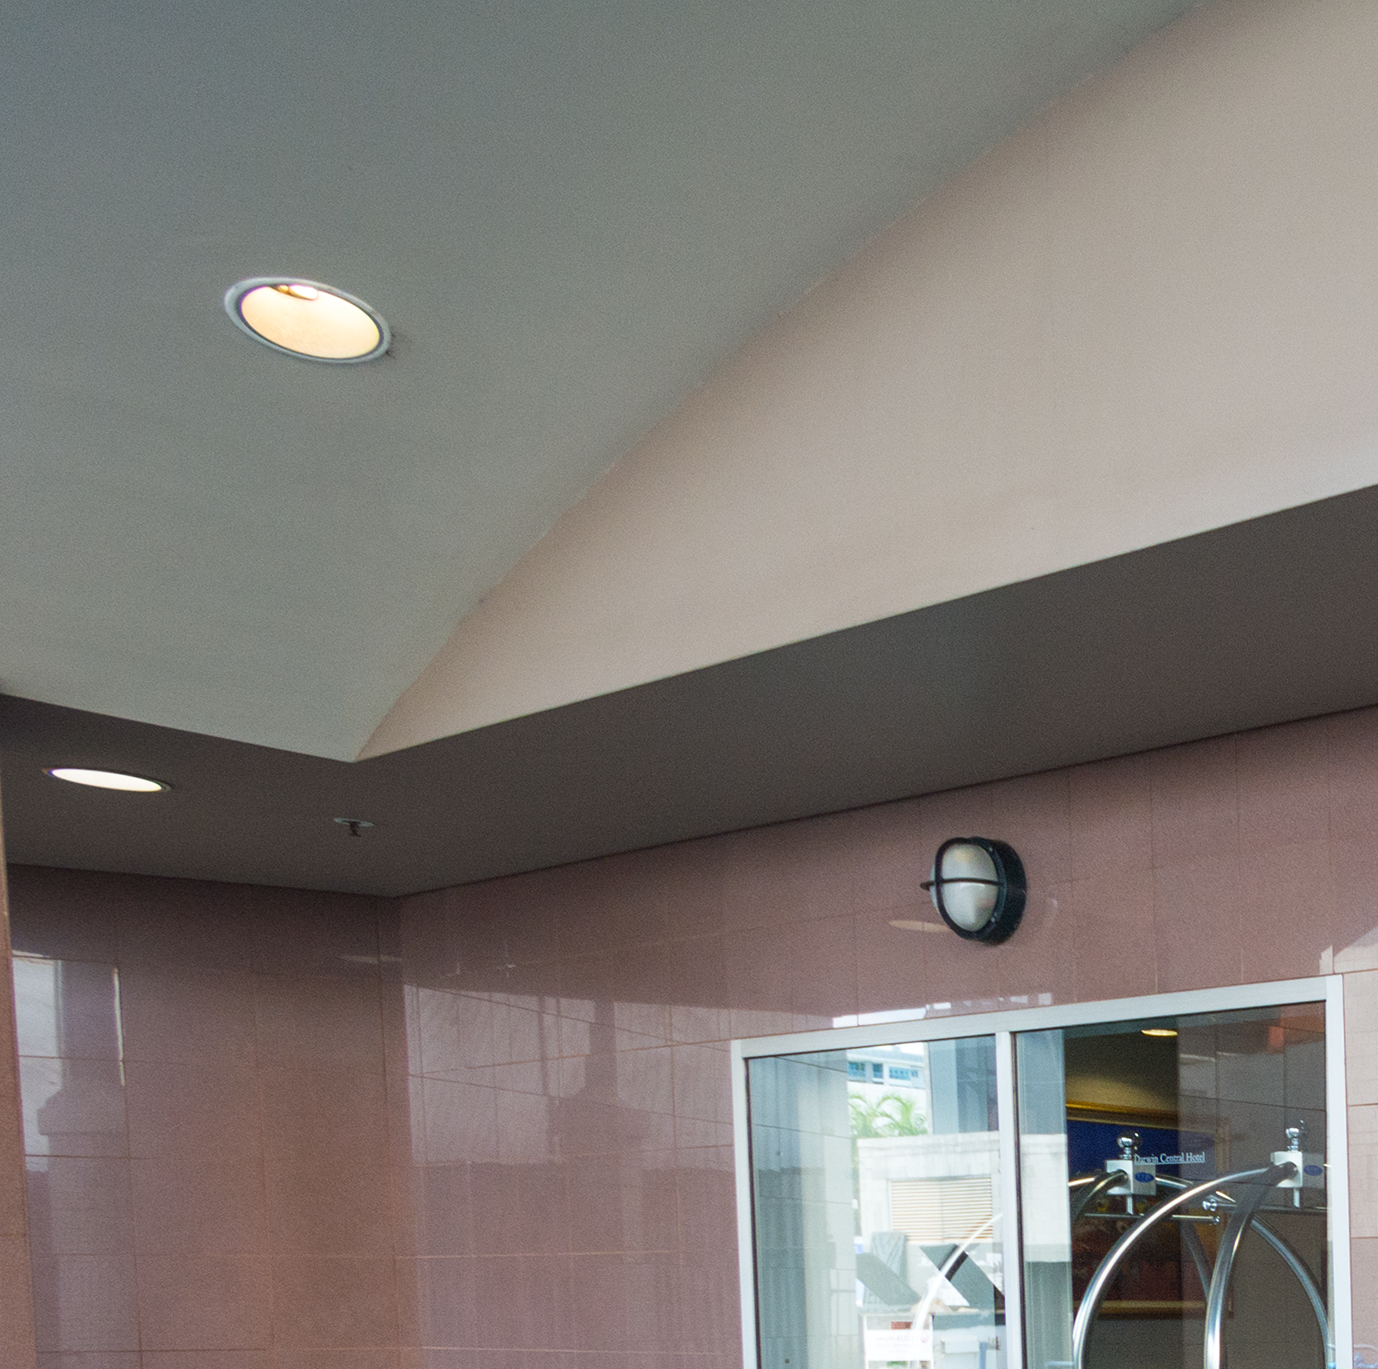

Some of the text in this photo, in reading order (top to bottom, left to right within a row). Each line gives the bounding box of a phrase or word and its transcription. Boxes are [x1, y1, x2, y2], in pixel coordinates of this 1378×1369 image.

[1134, 1151, 1206, 1164] Darwin Central Hotel
